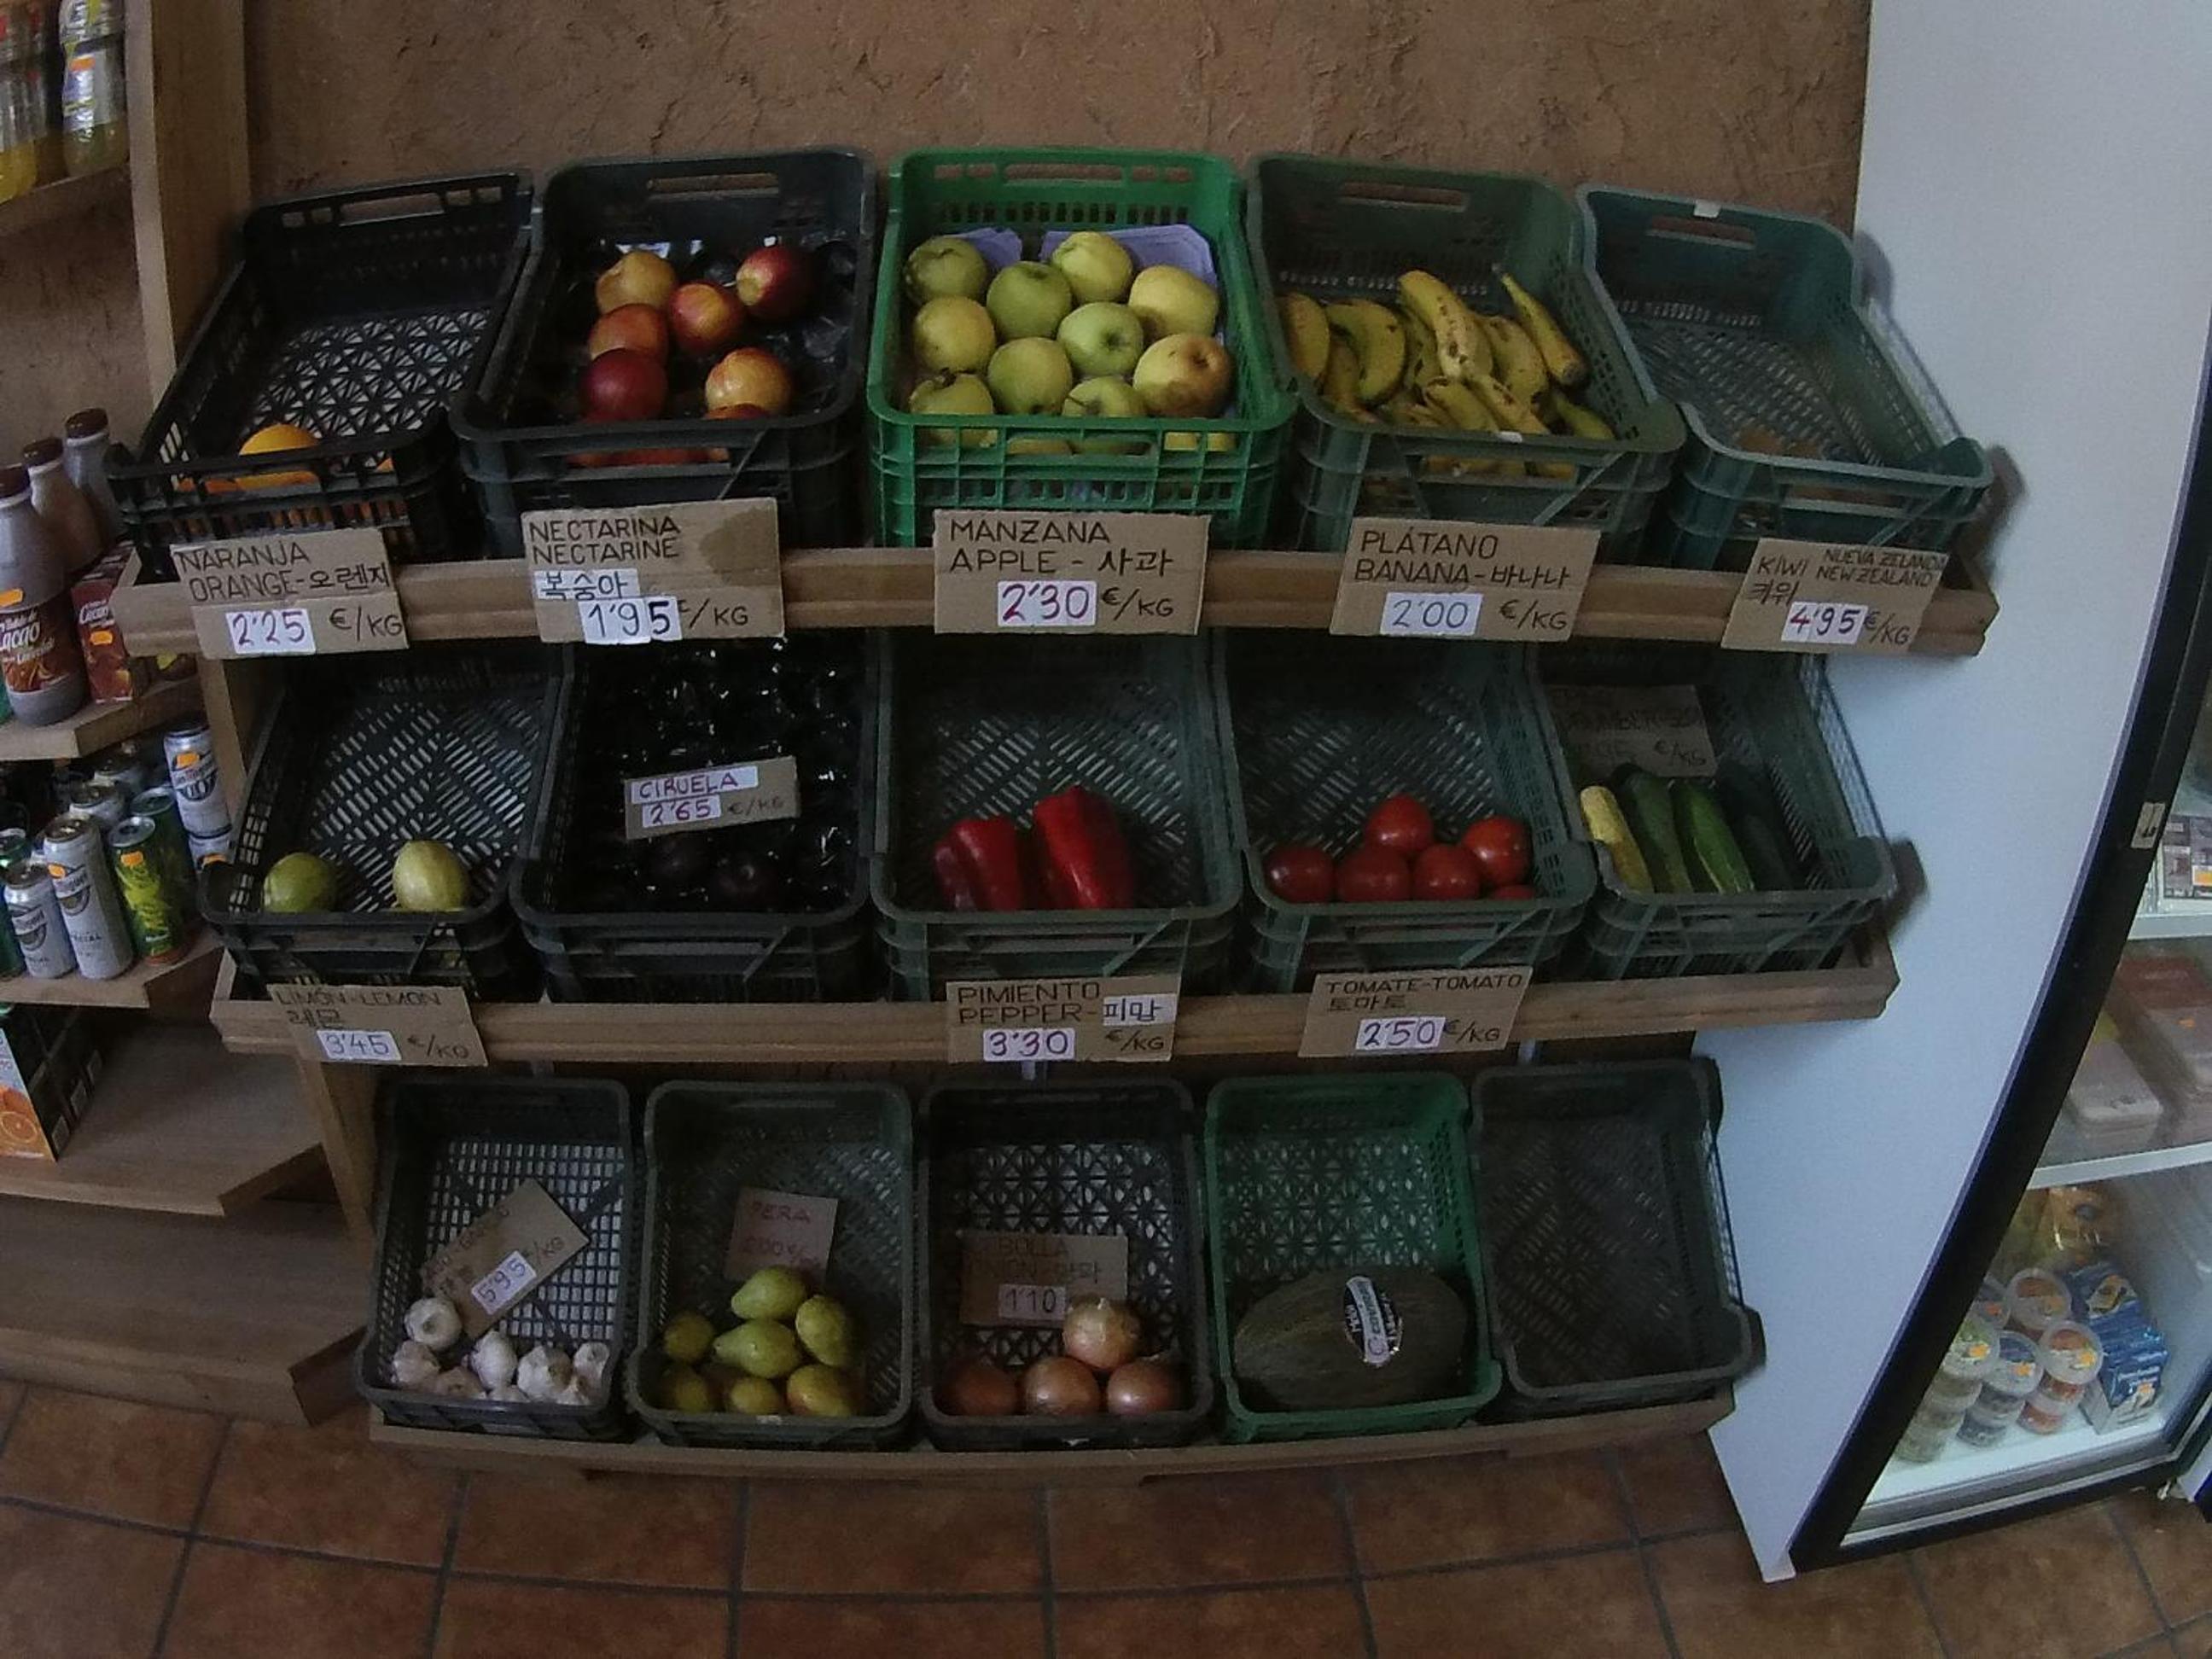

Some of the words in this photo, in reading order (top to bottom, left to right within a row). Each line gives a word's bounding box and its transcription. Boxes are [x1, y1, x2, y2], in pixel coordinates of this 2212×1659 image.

[529, 515, 681, 543] NECTARINA
[951, 519, 1109, 544] MANZANA
[533, 538, 680, 565] NECTARINE
[1361, 526, 1498, 559] PLÁTANO
[174, 540, 311, 572] NARANJA
[950, 548, 1057, 573] APPLE
[1757, 556, 1810, 577] KIWI
[1825, 550, 1875, 565] NUEVA
[1816, 566, 1854, 582] NEW
[640, 771, 738, 799] CIRUELA
[958, 981, 1100, 1004] PIMIENTO
